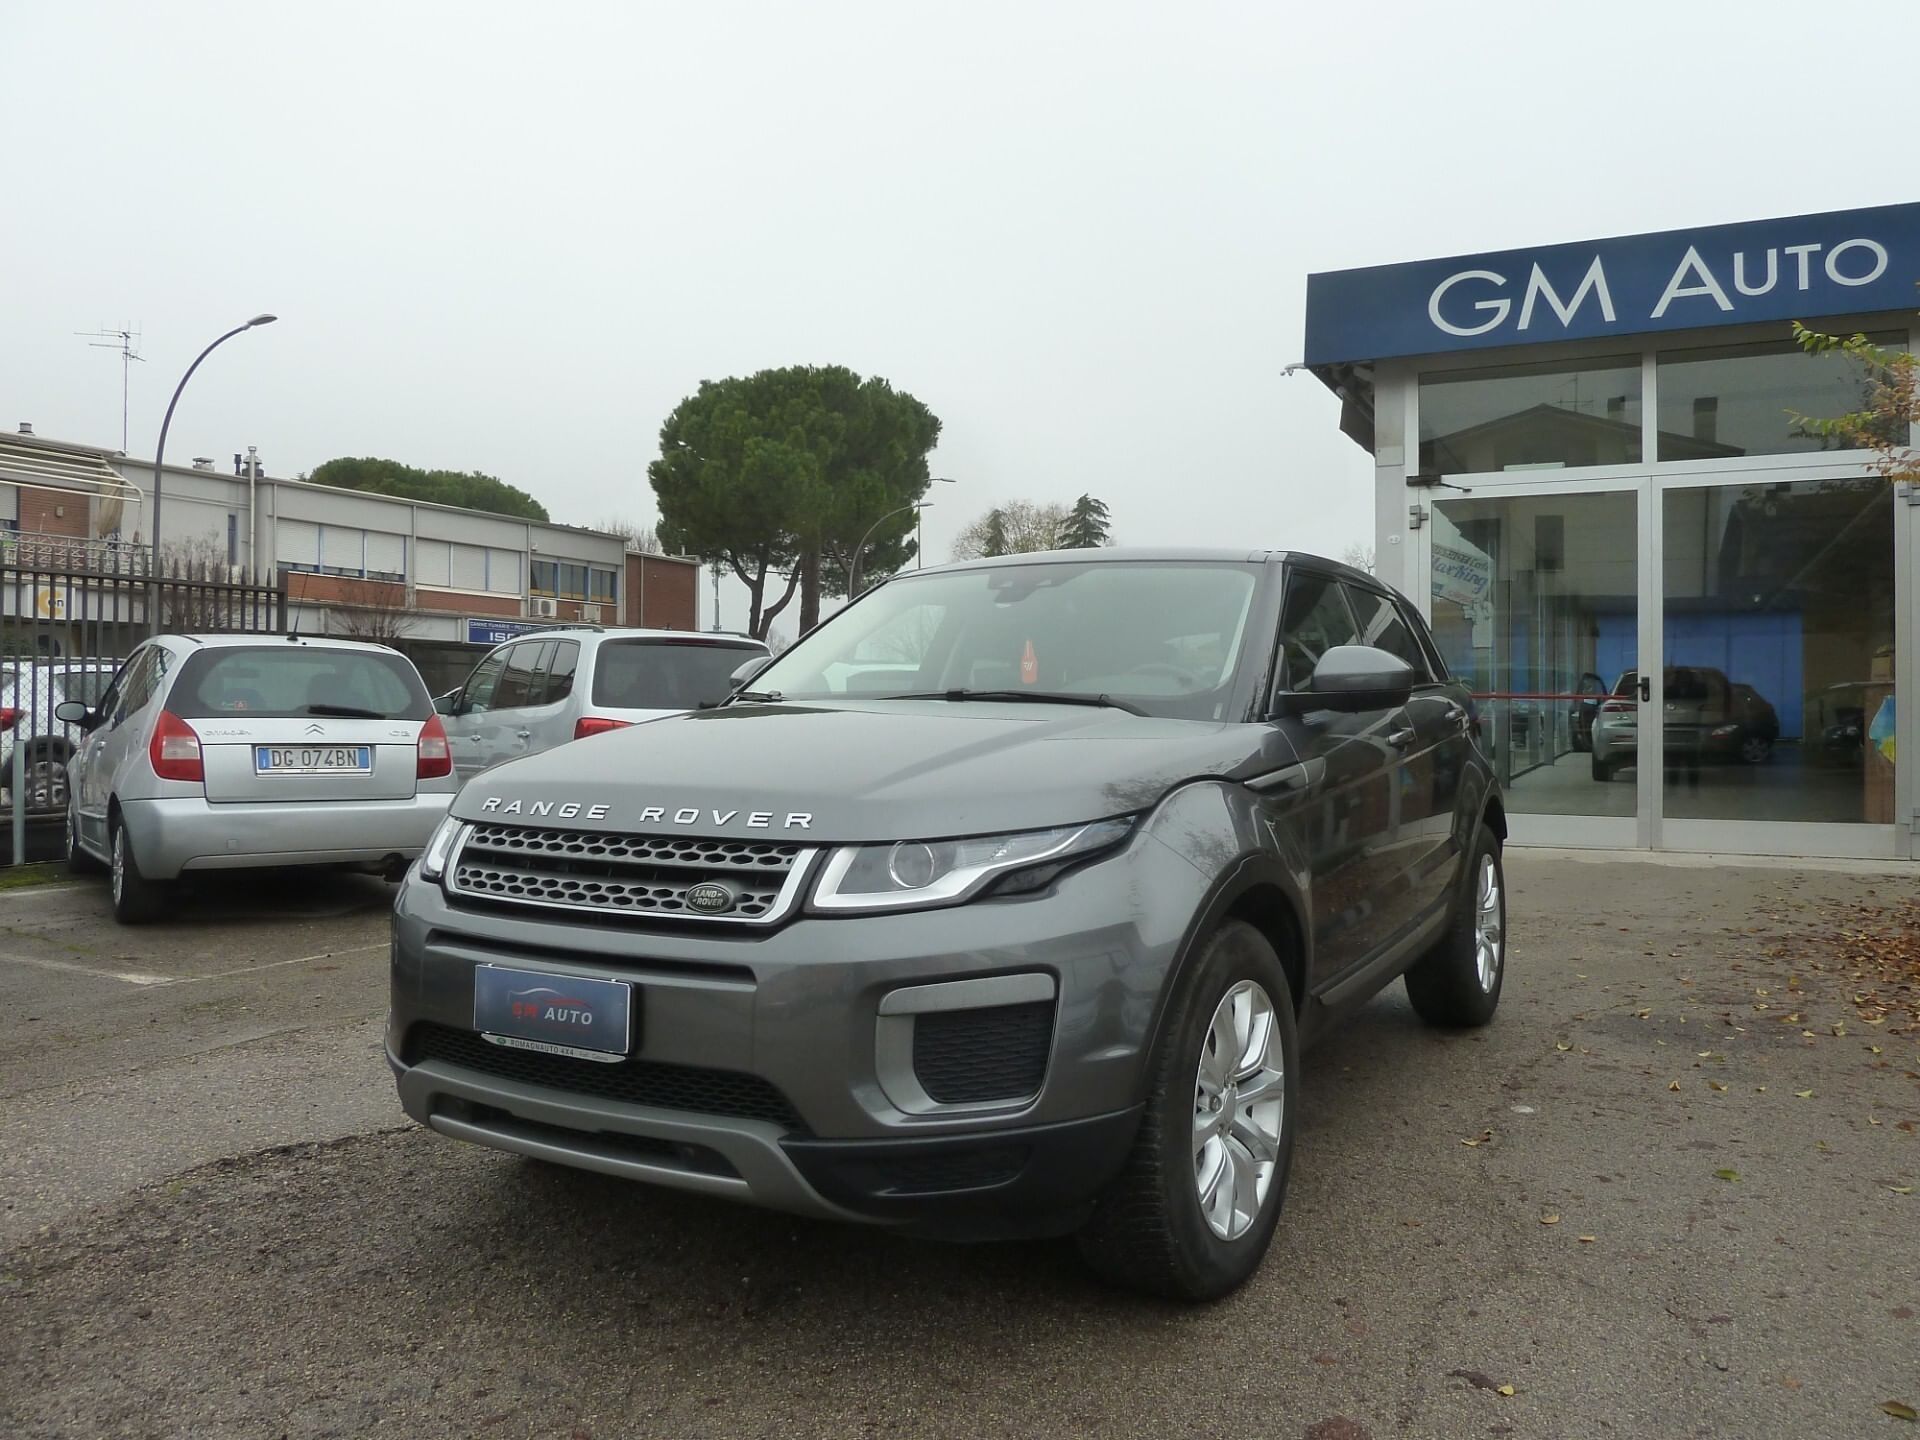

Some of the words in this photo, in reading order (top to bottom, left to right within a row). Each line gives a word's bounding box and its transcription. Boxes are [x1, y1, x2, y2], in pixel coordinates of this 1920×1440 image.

[1428, 255, 1616, 336] GM
[271, 750, 293, 767] DG
[302, 750, 357, 767] 074BN
[481, 797, 610, 820] RANGE
[639, 806, 813, 829] ROVER
[695, 890, 718, 898] LAND
[696, 897, 724, 907] ROVER
[544, 1007, 593, 1025] AUTO
